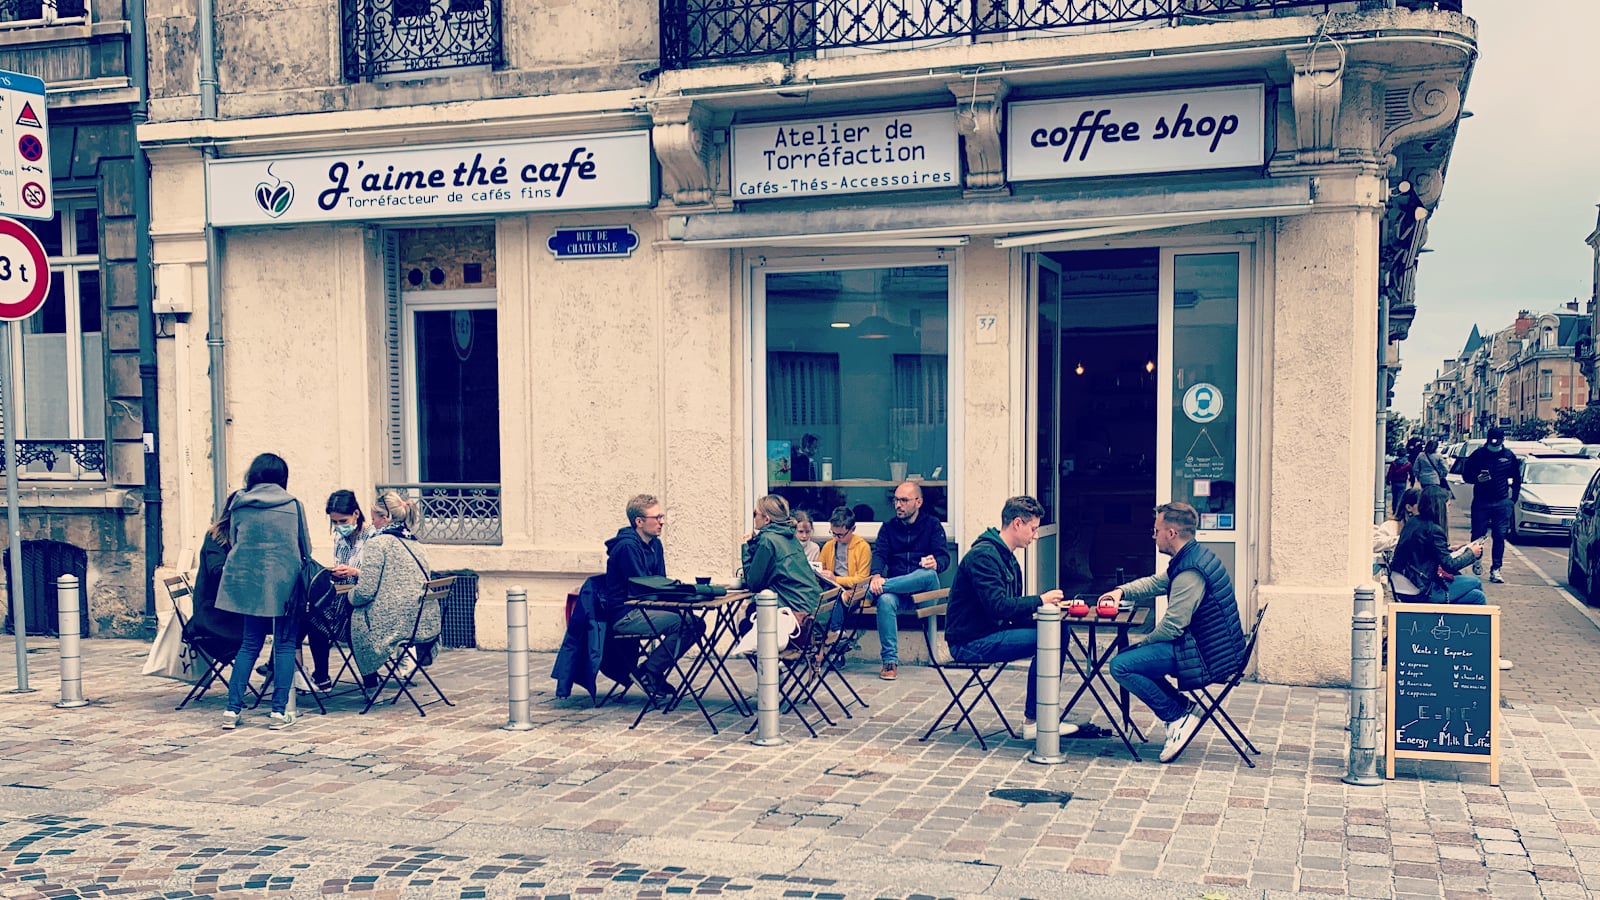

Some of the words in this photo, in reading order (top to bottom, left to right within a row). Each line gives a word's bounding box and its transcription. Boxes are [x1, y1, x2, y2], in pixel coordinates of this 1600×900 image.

[775, 122, 870, 148] Atelier
[885, 119, 912, 140] de
[1030, 109, 1141, 162] coffee
[1152, 103, 1239, 152] shop
[763, 142, 925, 171] Torréfaction
[452, 153, 509, 187] thé
[520, 147, 597, 198] café
[347, 194, 439, 208] Torréfacteur
[447, 191, 463, 203] de
[471, 188, 511, 202] cafés
[521, 187, 551, 199] fins
[576, 231, 593, 242] RUE
[597, 230, 608, 241] DE
[567, 241, 618, 254] CHATIVESLE
[19, 264, 29, 283] t
[979, 317, 996, 331] 37
[1396, 729, 1429, 748] Energy
[1439, 731, 1461, 746] Milk
